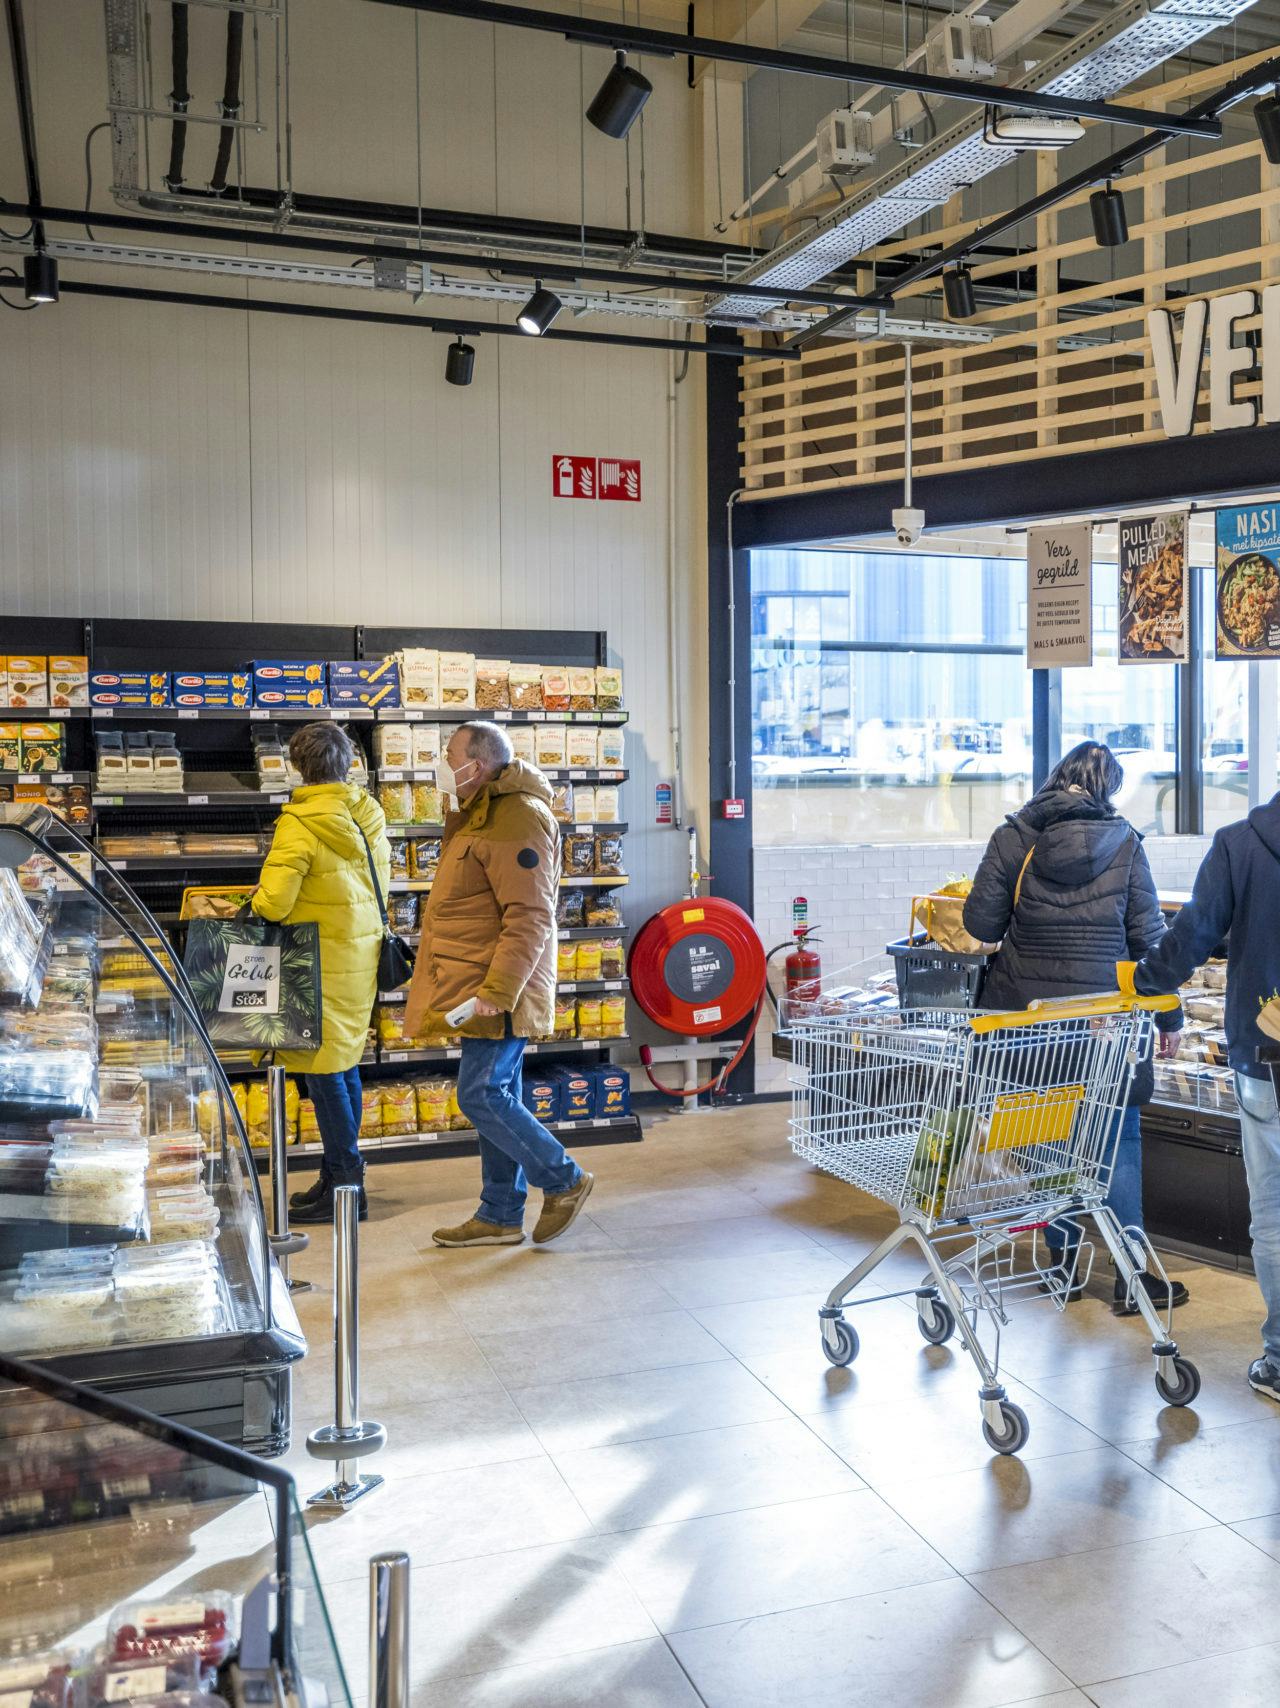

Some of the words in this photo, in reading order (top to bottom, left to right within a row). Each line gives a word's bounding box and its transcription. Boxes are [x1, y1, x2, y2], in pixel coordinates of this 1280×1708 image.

[1237, 508, 1277, 537] NASI
[1122, 521, 1166, 548] PULLED
[1045, 540, 1072, 558] Vers
[1232, 539, 1250, 552] met
[1128, 543, 1161, 568] MEAT
[1037, 558, 1079, 585] gegrild
[1034, 640, 1049, 649] MALS
[1050, 640, 1054, 648] &
[1055, 635, 1086, 647] SMAAKVOL
[244, 955, 266, 964] groen
[691, 960, 720, 973] saval
[228, 963, 277, 981] Geluk
